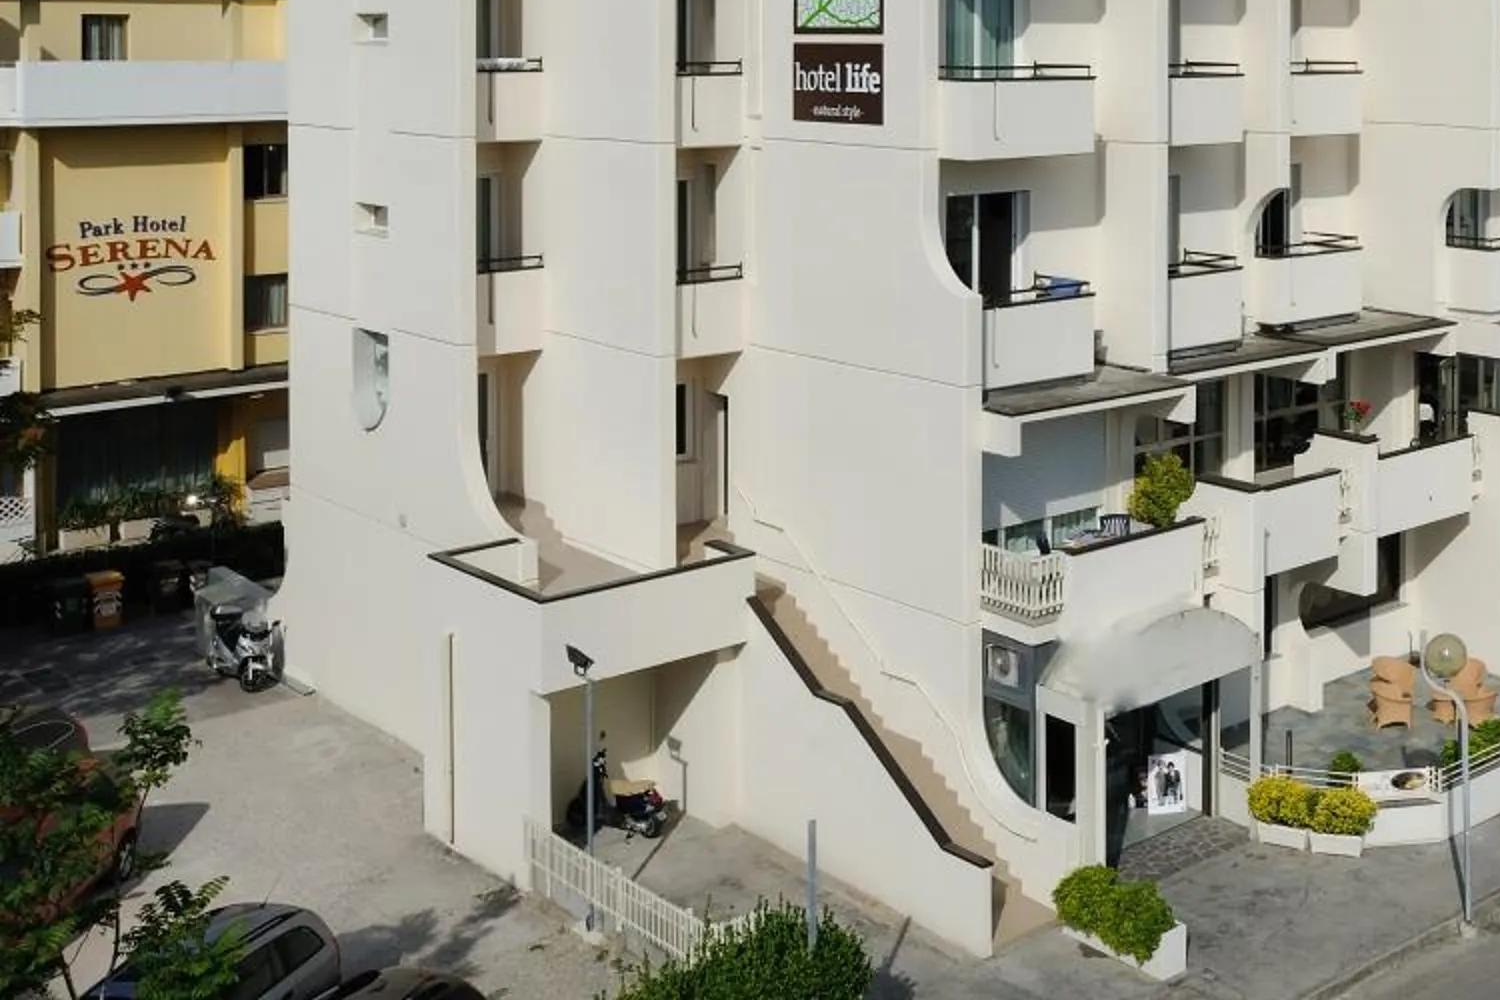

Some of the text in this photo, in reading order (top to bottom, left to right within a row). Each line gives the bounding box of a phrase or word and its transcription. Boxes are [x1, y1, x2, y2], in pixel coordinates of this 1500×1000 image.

[794, 61, 881, 94] hotel life
[80, 215, 187, 239] Park Hotel
[45, 238, 217, 273] SERENA
